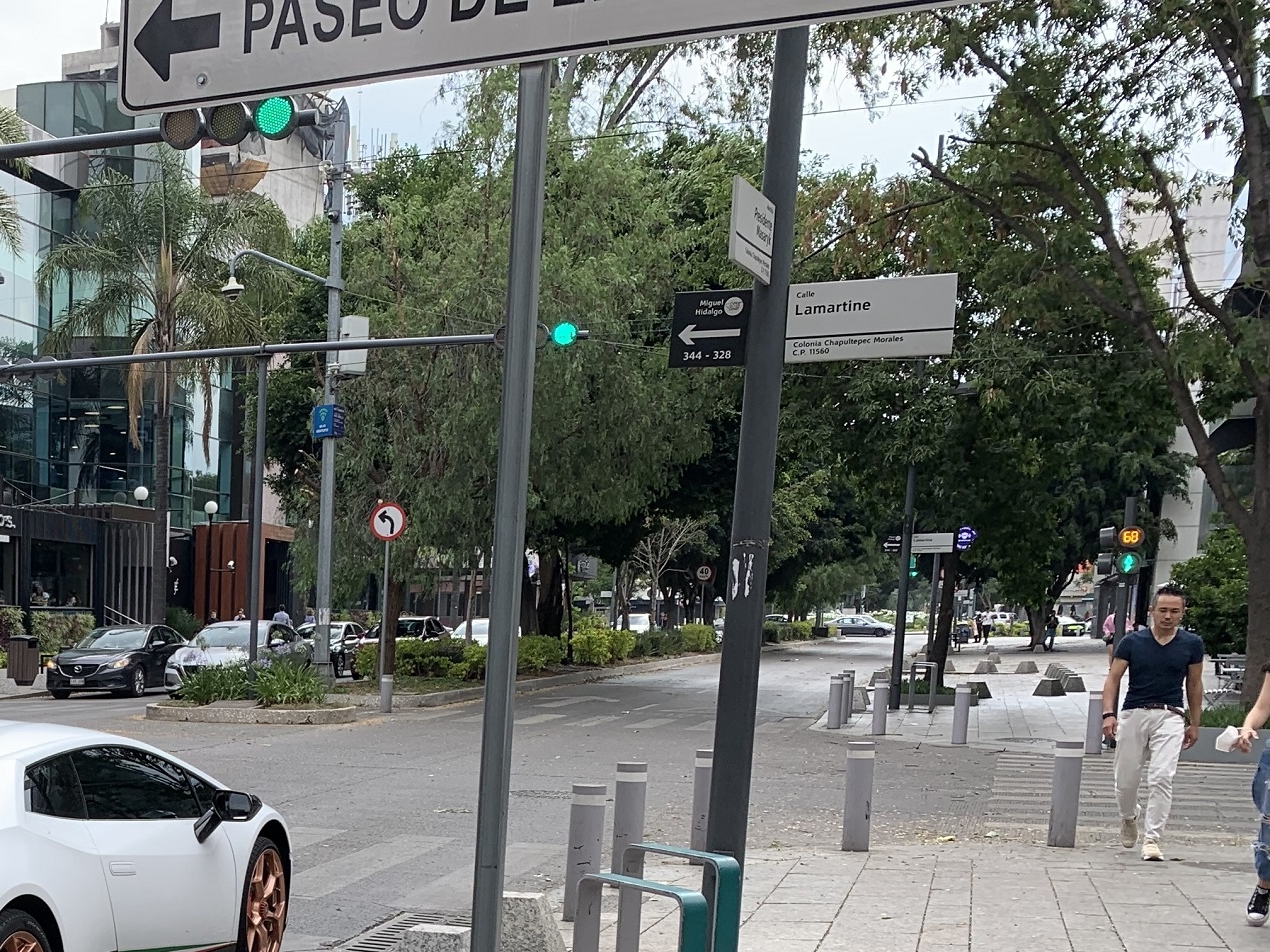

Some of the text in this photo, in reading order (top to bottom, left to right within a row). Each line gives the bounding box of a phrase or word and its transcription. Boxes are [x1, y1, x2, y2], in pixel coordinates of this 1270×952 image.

[699, 299, 724, 308] Miguel
[795, 300, 871, 315] Lamartine
[695, 308, 723, 316] Hidalgo
[824, 338, 871, 347] Chapultepec
[873, 335, 904, 343] Morales
[683, 351, 702, 361] 344
[713, 350, 731, 360] 328
[809, 347, 829, 355] 11560
